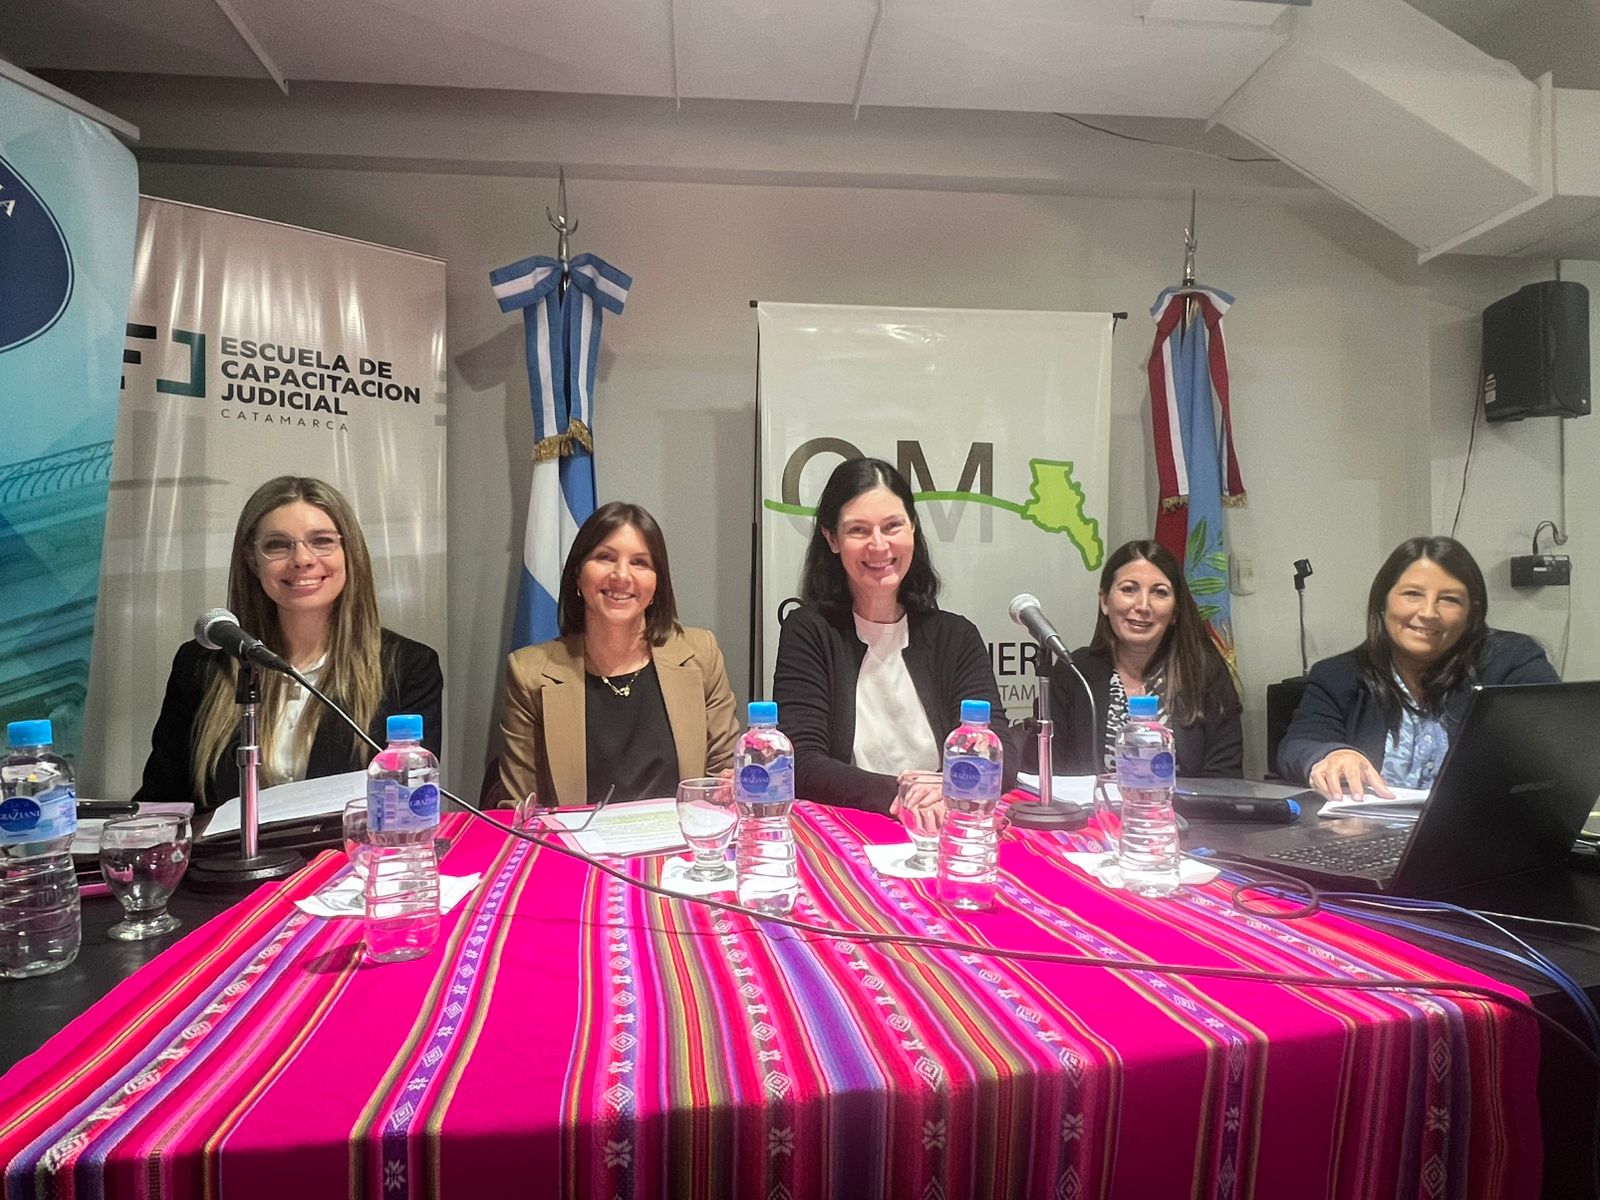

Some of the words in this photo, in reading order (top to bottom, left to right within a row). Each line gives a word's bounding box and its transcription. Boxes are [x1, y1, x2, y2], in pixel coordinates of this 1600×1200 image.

[221, 336, 350, 373] ESCUELA
[359, 357, 392, 379] DE
[221, 360, 420, 404] CAPACITACION
[221, 383, 348, 416] JUDICIAL
[221, 408, 348, 432] CATAMARCA
